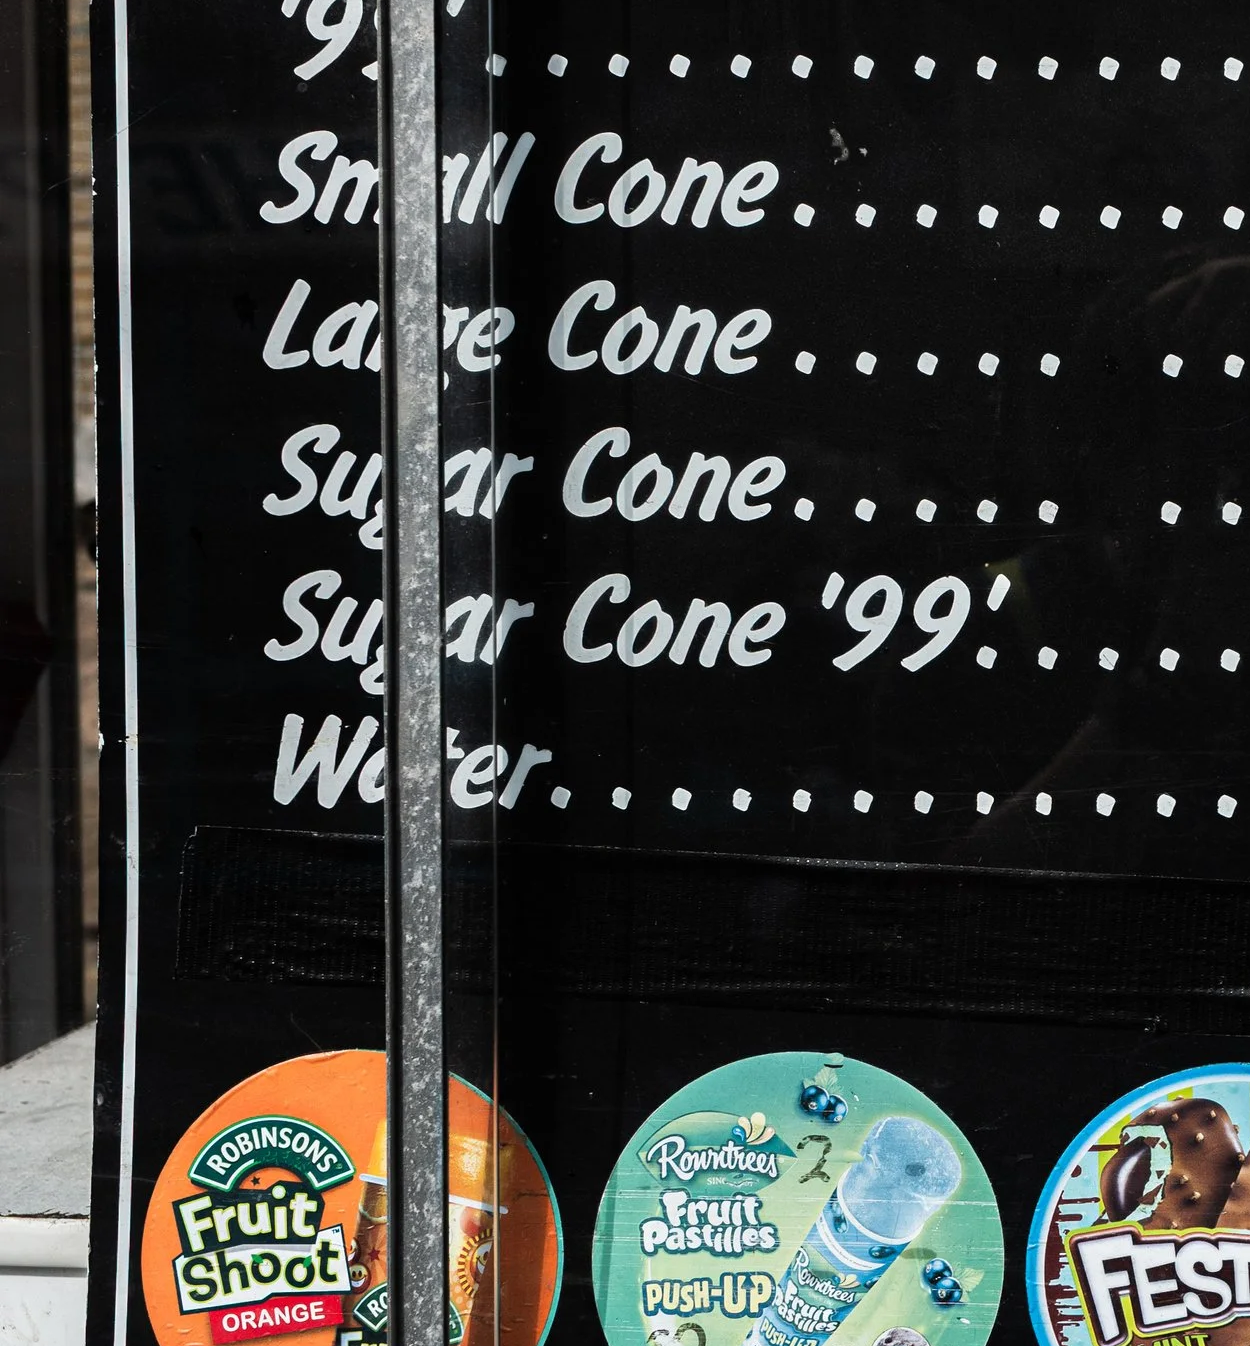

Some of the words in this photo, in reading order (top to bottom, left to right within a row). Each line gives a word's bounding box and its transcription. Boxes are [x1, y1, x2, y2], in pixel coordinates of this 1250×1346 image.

[554, 131, 780, 229] Cone
[262, 278, 515, 391] Lae
[548, 279, 772, 376] Cone
[562, 426, 787, 522] Cone
[562, 573, 787, 668] Cone
[273, 713, 553, 810] Wer
[205, 1126, 338, 1176] ROBINSONS
[647, 1135, 778, 1182] Rowntrees
[179, 1184, 319, 1253] Fruit
[661, 1190, 760, 1227] Fruit
[641, 1219, 777, 1253] Pastilles
[182, 1239, 340, 1303] Shoot
[645, 1274, 773, 1315] PUSH-UP
[222, 1300, 326, 1333] ORANGE
[772, 1284, 839, 1333] Pastilles
[784, 1278, 834, 1323] Fruit
